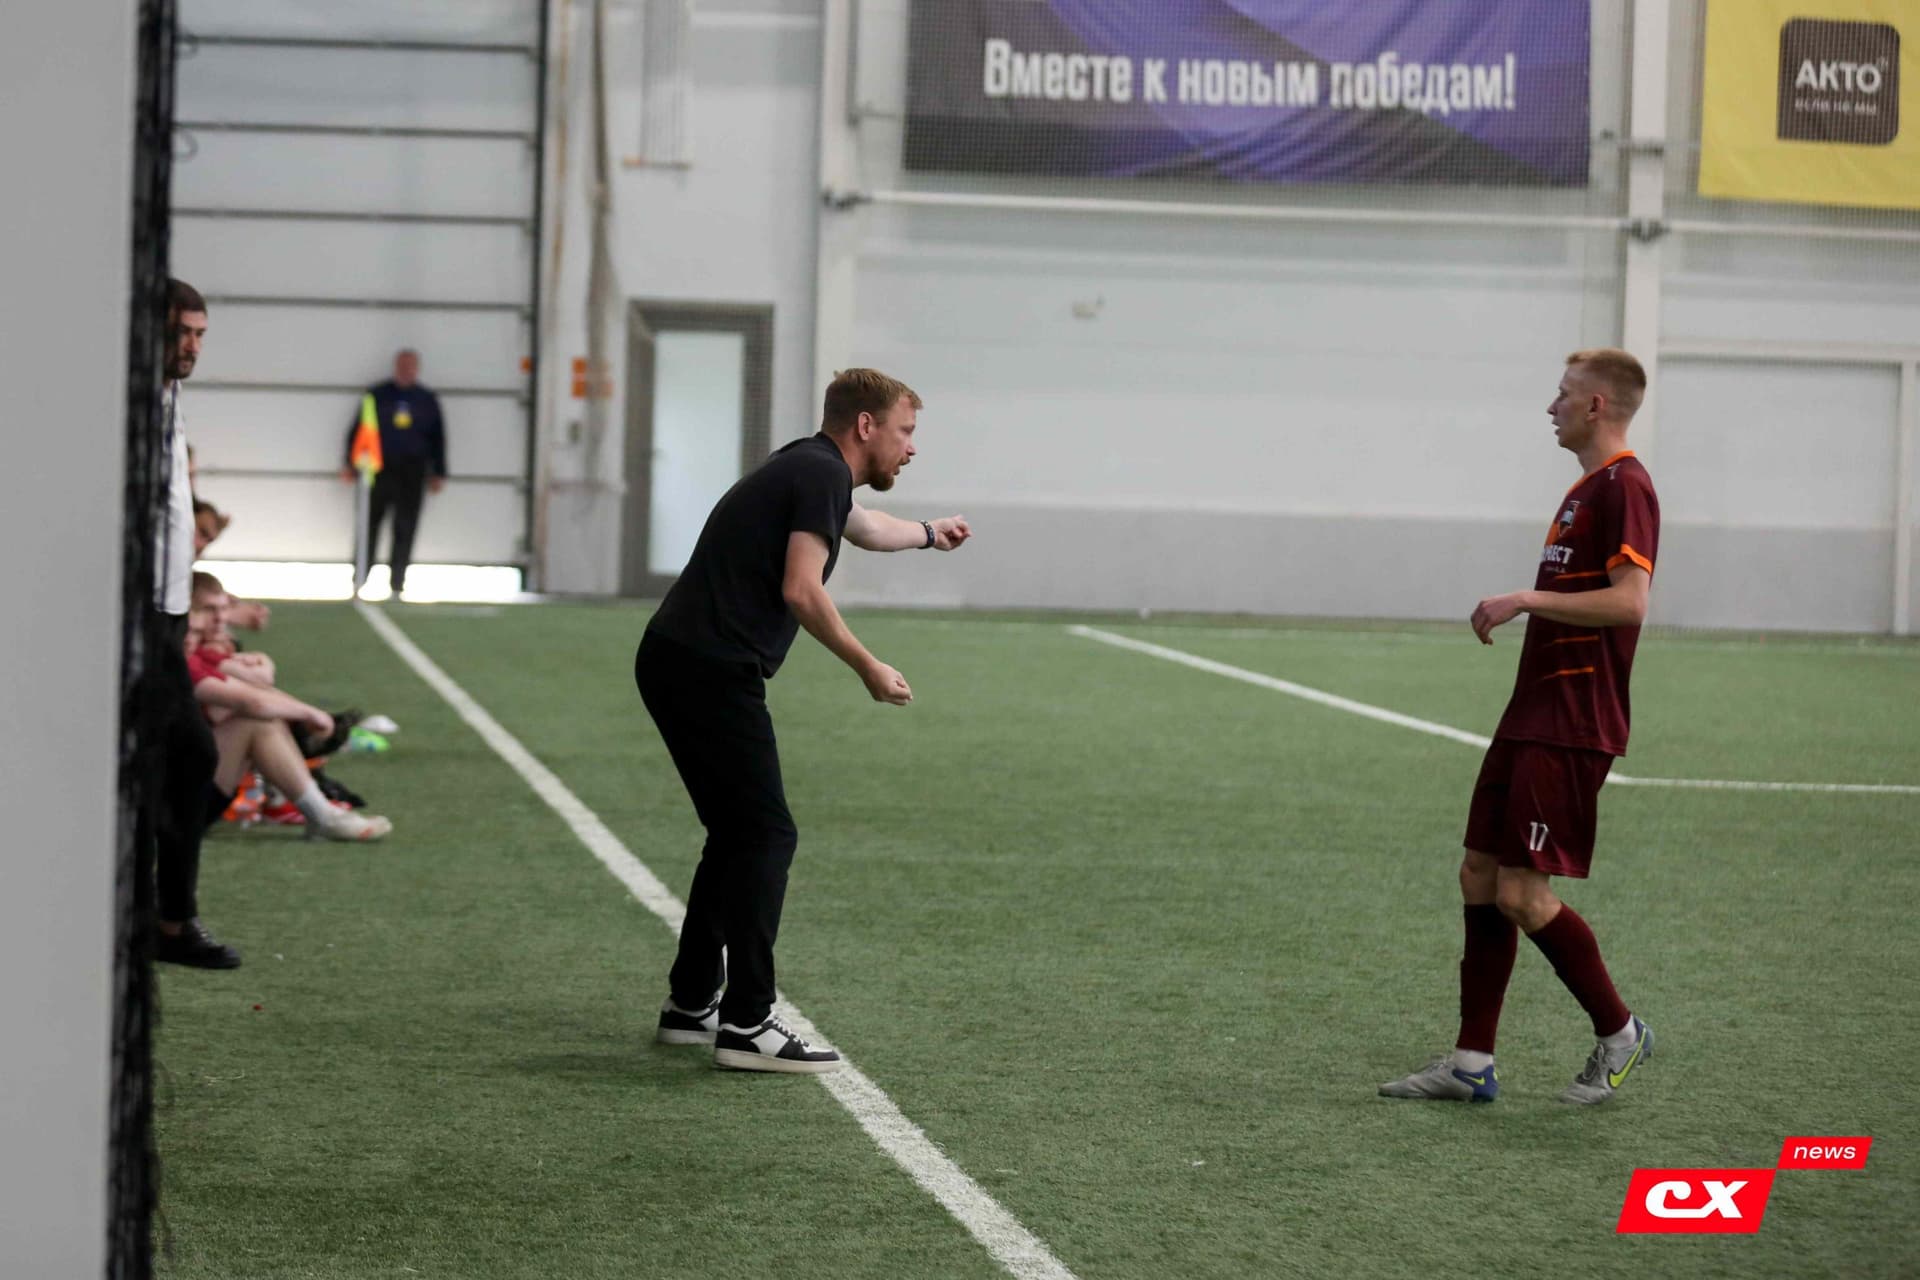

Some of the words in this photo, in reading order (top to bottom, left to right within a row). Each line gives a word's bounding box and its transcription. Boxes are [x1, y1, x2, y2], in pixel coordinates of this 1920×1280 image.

[984, 38, 1132, 102] Вместе
[1143, 57, 1167, 104] к
[1179, 58, 1320, 107] новым
[1330, 51, 1516, 116] победам!
[1529, 821, 1549, 851] 17
